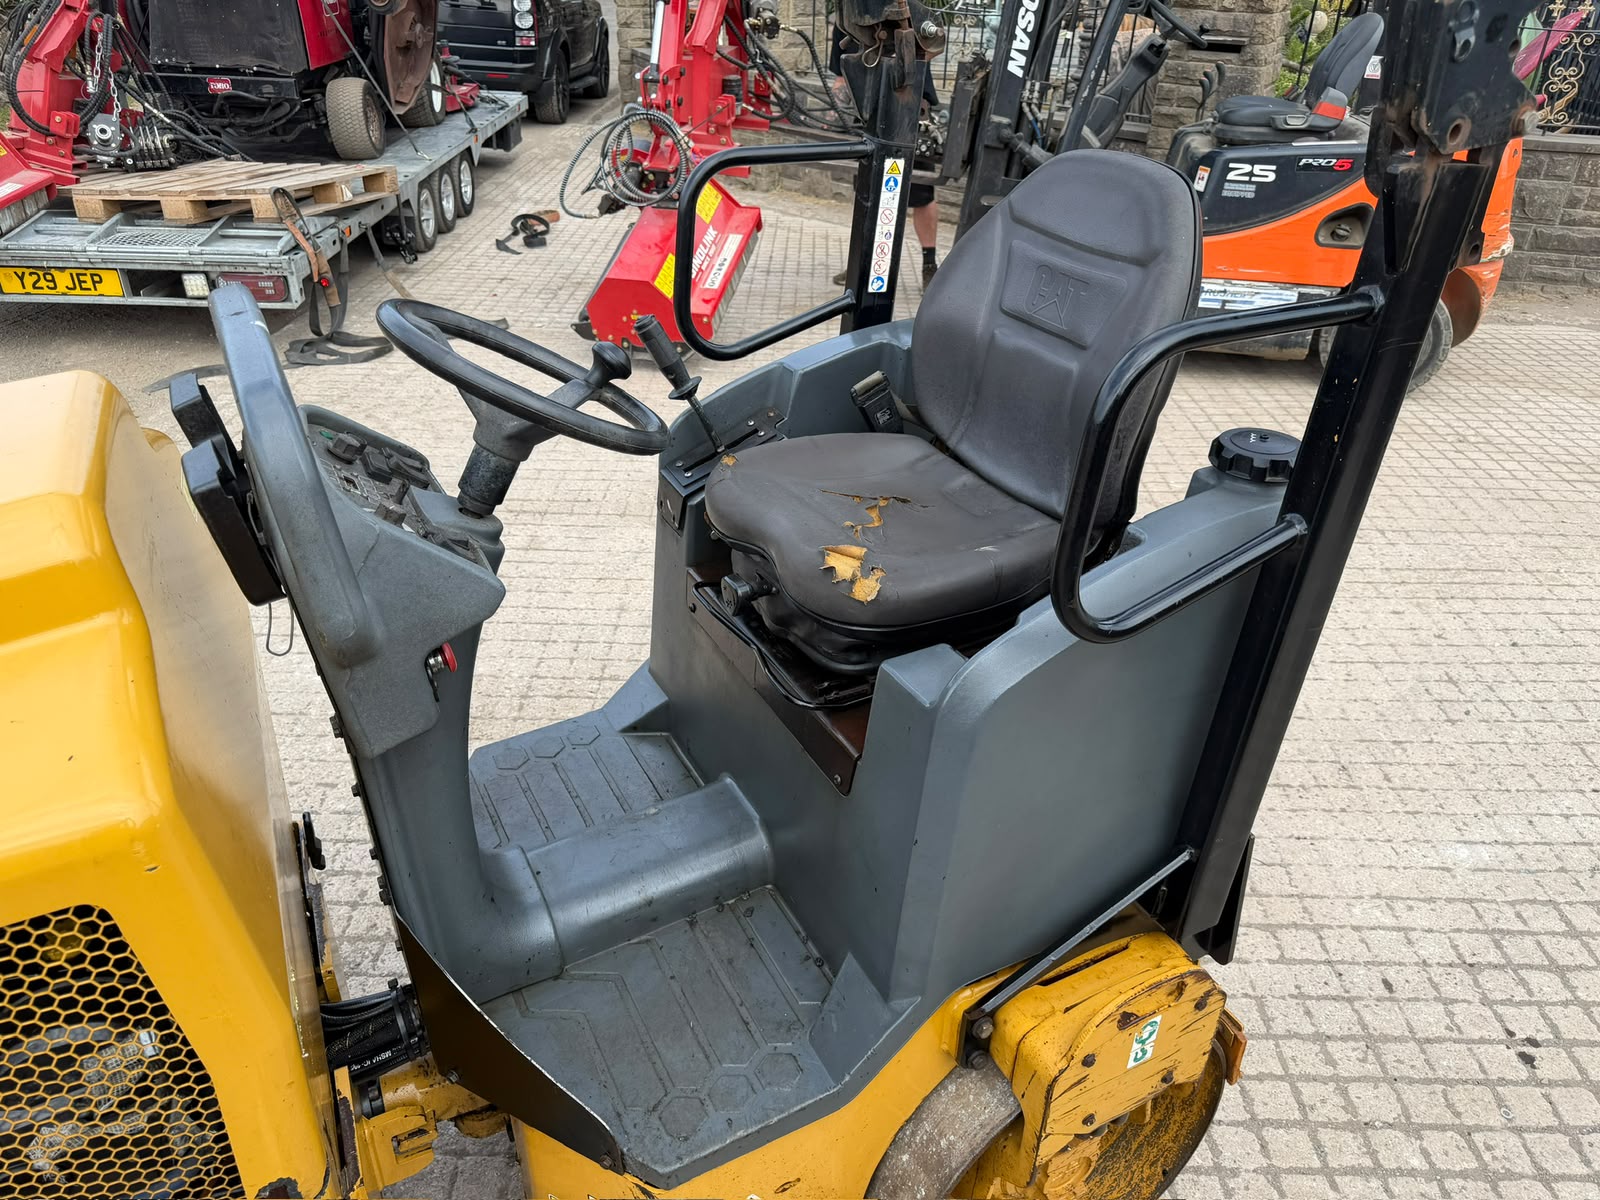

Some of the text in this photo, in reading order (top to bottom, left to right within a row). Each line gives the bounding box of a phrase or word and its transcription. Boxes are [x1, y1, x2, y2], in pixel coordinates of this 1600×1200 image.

[1226, 163, 1277, 182] 25
[14, 271, 103, 291] Y29 JEP
[1024, 265, 1090, 329] CAT
